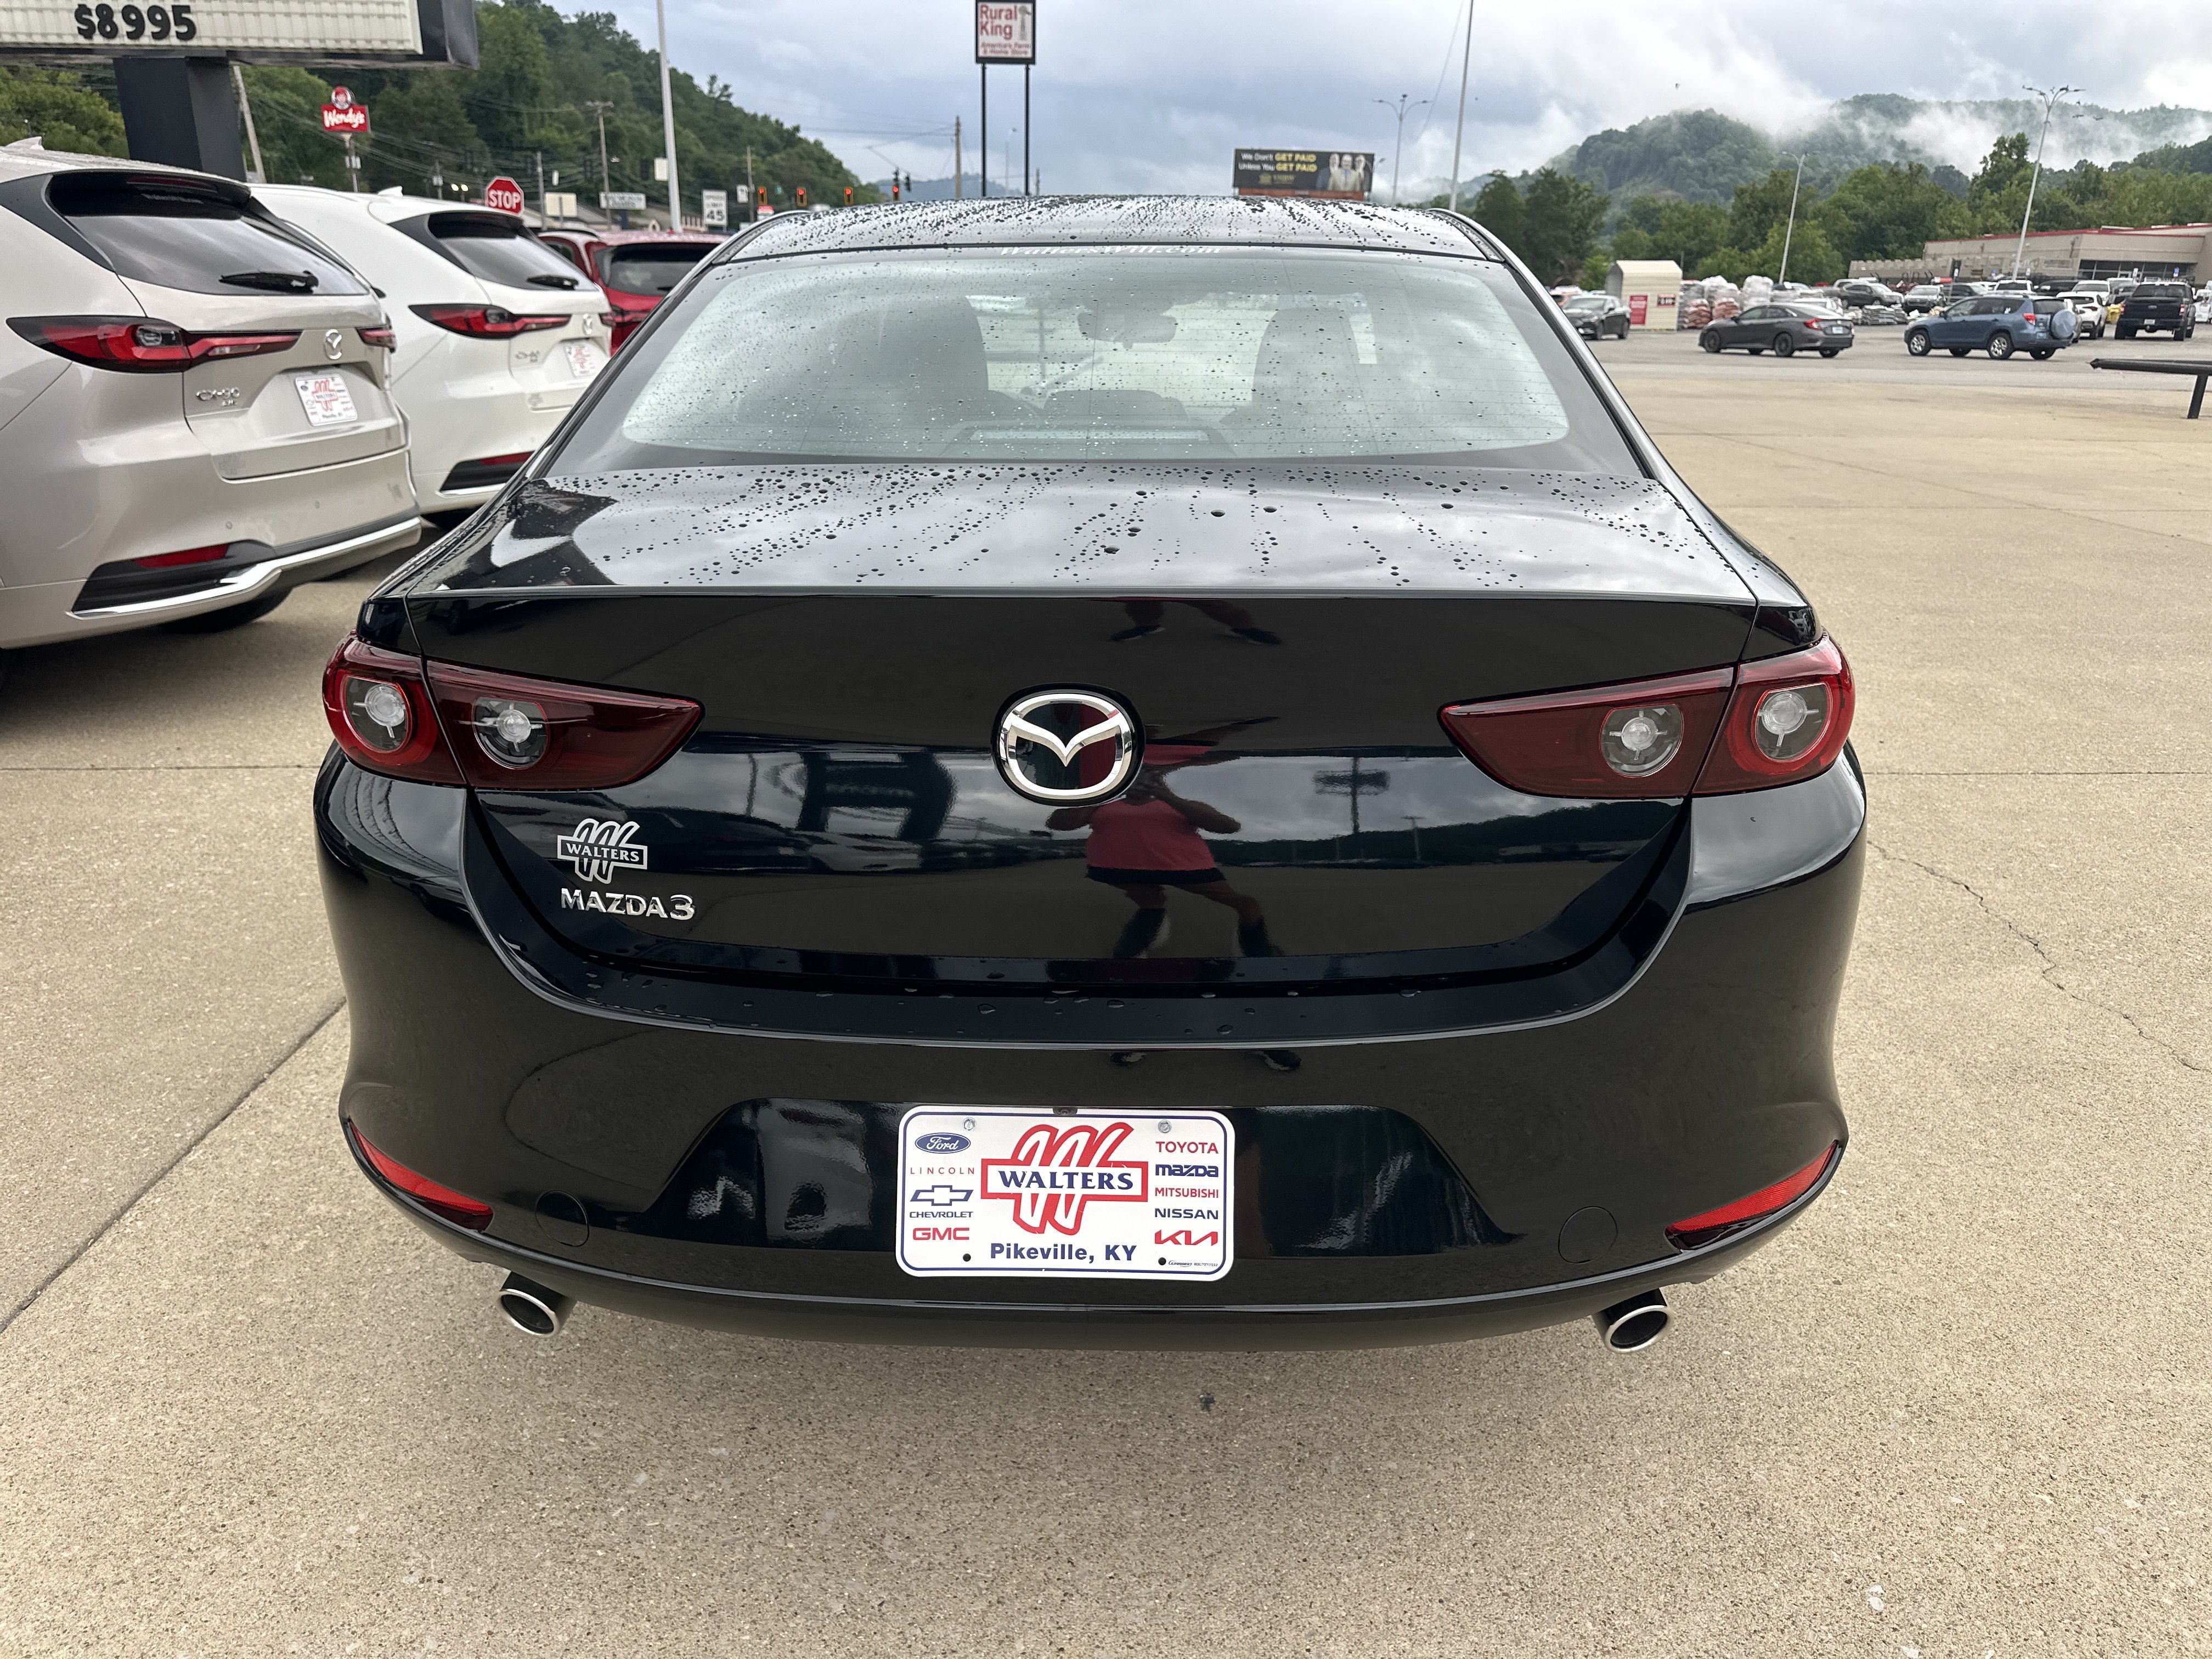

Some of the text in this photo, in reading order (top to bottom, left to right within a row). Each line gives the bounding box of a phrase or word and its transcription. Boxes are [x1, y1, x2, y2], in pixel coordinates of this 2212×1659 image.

[980, 4, 1018, 20] Rural
[75, 3, 196, 41] $8995
[980, 20, 1012, 40] King
[323, 108, 365, 128] Wendy's
[1275, 153, 1294, 161] GET
[1294, 153, 1317, 162] PAID
[1276, 162, 1294, 171] GET
[1295, 163, 1317, 172] PAID
[488, 189, 521, 210] STOP
[707, 210, 725, 221] 45
[566, 842, 640, 862] WALTERS
[561, 888, 695, 921] MAZDA3
[926, 1136, 960, 1150] Ford
[1155, 1141, 1218, 1154] TOYOTA
[997, 1170, 1133, 1190] WALTERS
[1155, 1187, 1218, 1198] MITSUBISHI
[1154, 1208, 1218, 1220] NISSAN
[912, 1227, 970, 1240] GMC
[1154, 1229, 1218, 1246] KIA
[990, 1243, 1137, 1264] Pikeville, KY
